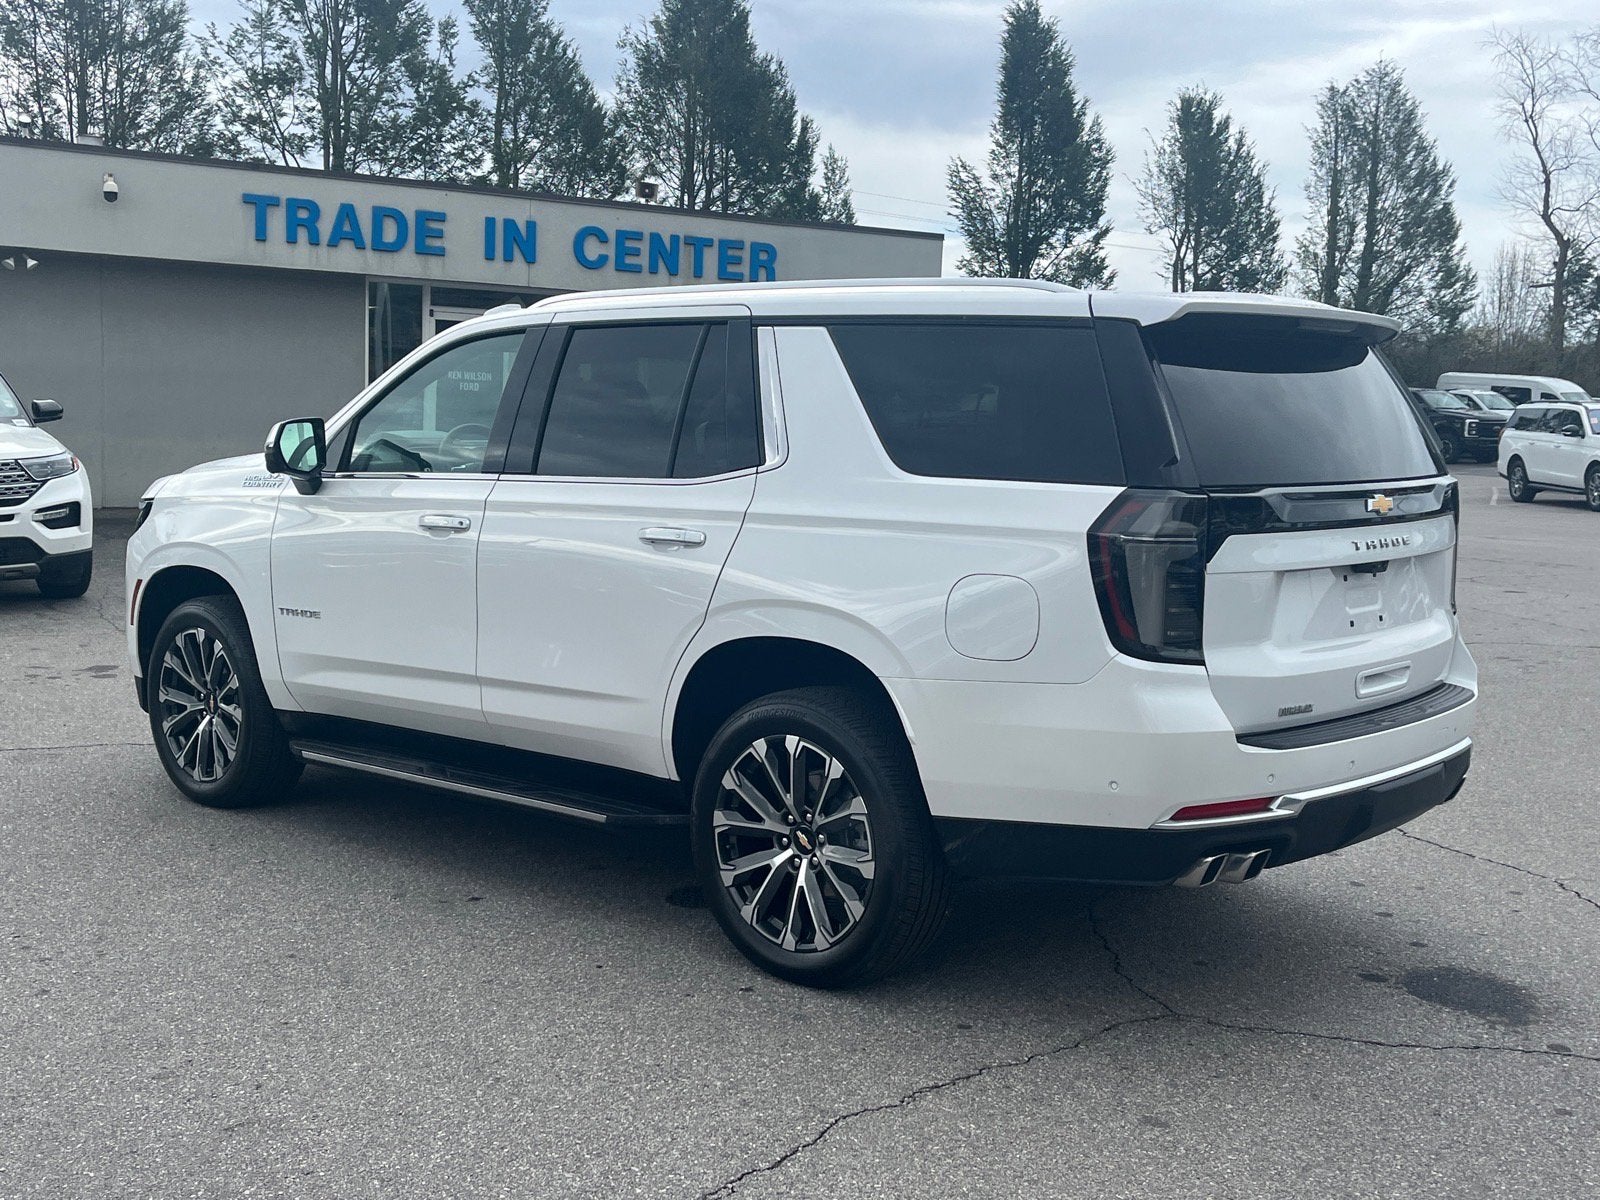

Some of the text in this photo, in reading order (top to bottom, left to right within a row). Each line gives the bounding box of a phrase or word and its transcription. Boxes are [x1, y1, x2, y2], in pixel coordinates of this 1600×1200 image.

[242, 192, 778, 282] TRADE IN CENTER
[448, 370, 492, 381] KEN WILSON
[459, 382, 480, 391] FORD
[1351, 535, 1410, 551] TAHOE
[278, 607, 321, 619] TAHOE
